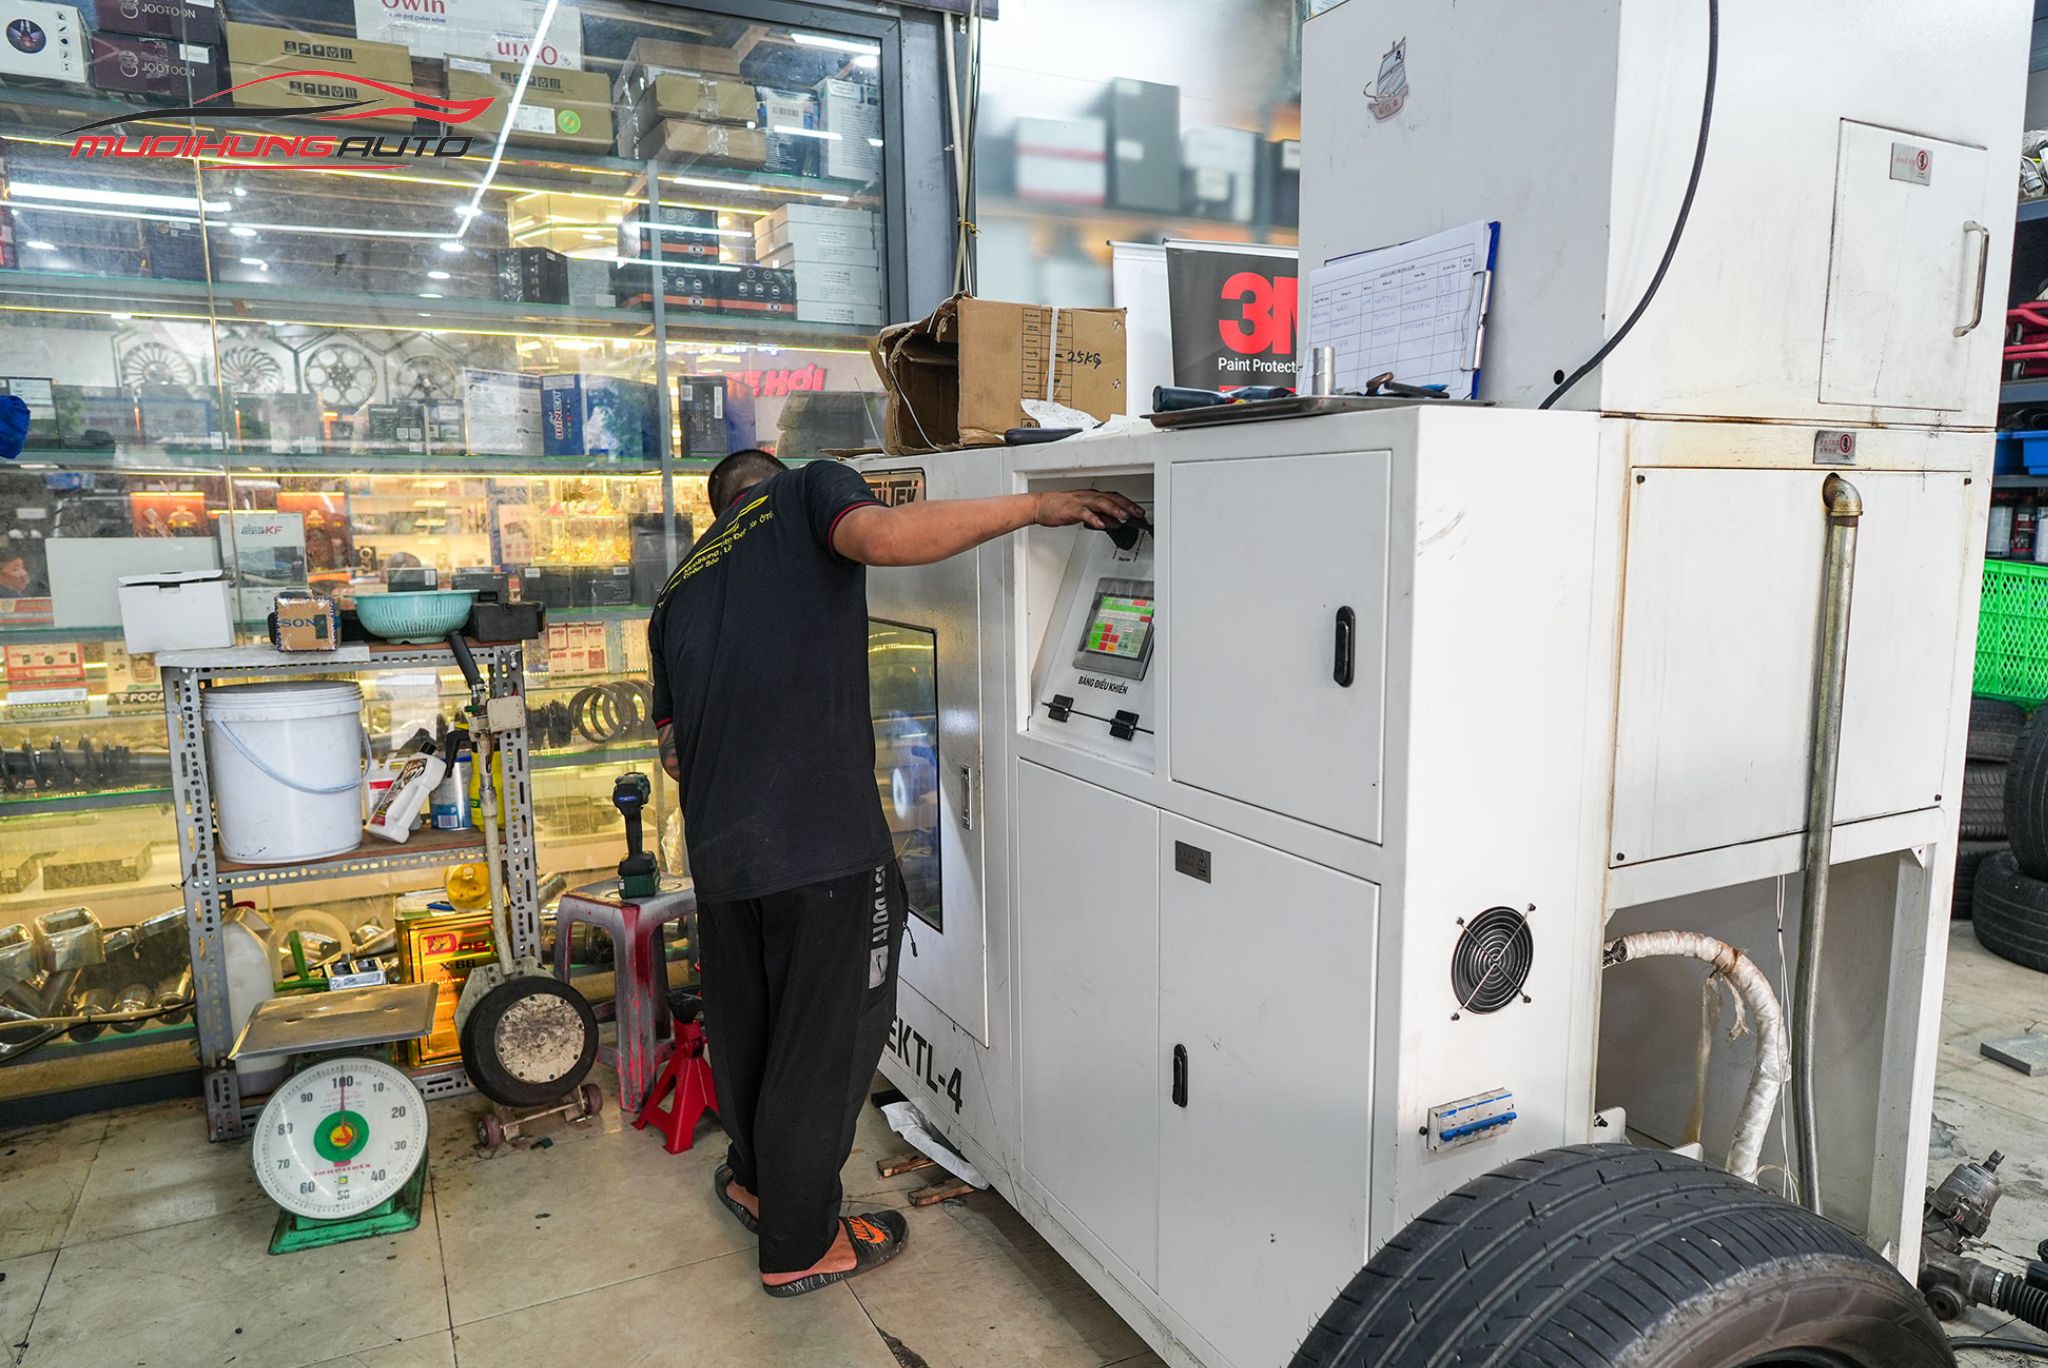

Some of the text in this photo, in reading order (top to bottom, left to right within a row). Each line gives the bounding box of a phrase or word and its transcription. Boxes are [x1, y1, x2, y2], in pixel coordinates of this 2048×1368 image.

[1218, 357, 1250, 371] Paint
[332, 1076, 353, 1089] 100
[373, 1083, 384, 1093] 10
[301, 1093, 313, 1103] 90
[391, 1106, 406, 1118] 20
[394, 1140, 407, 1150] 30
[277, 1159, 290, 1169] 70
[371, 1169, 386, 1182] 40
[300, 1182, 315, 1194] 60
[337, 1190, 350, 1200] 50
